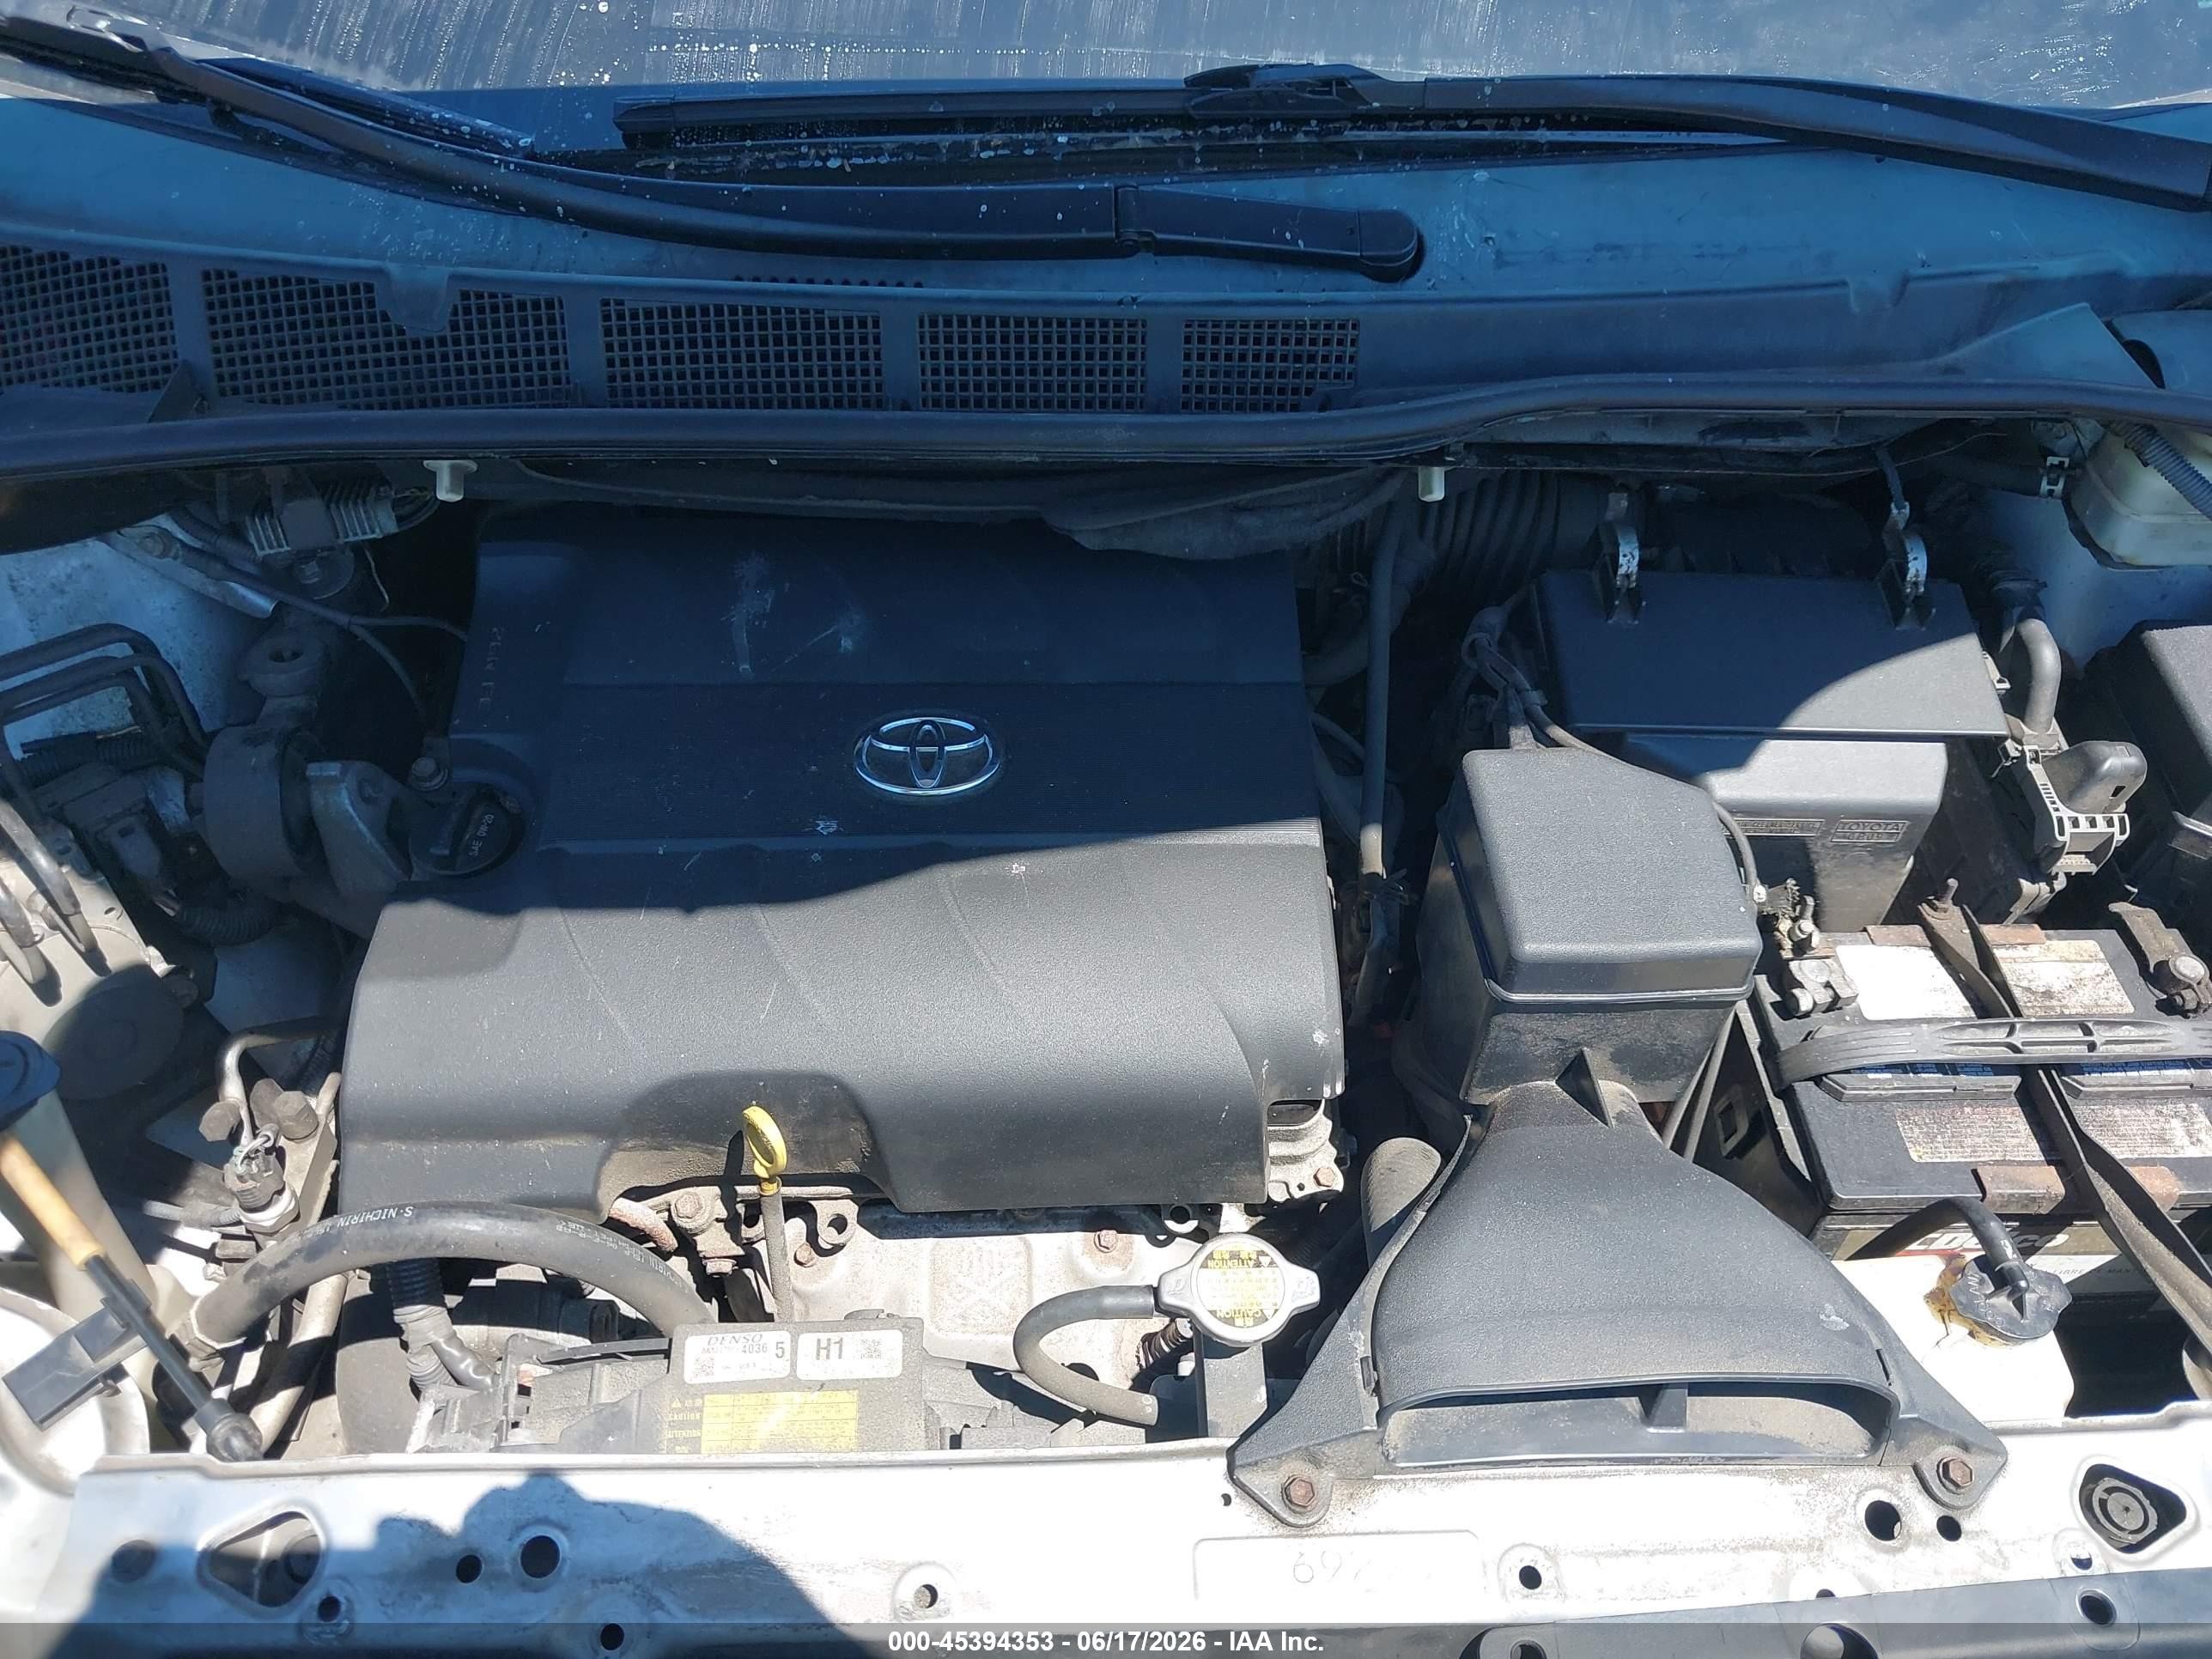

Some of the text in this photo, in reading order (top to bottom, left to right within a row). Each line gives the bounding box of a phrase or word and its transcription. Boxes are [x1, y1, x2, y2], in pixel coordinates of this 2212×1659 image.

[1838, 822, 1902, 832] TOYOTA
[469, 814, 495, 857] SAE 0W-20
[1208, 1259, 1257, 1267] ATTENTION
[1216, 1310, 1261, 1319] CAUTION
[708, 1334, 763, 1346] DENSO
[775, 1337, 844, 1360] 5 H1
